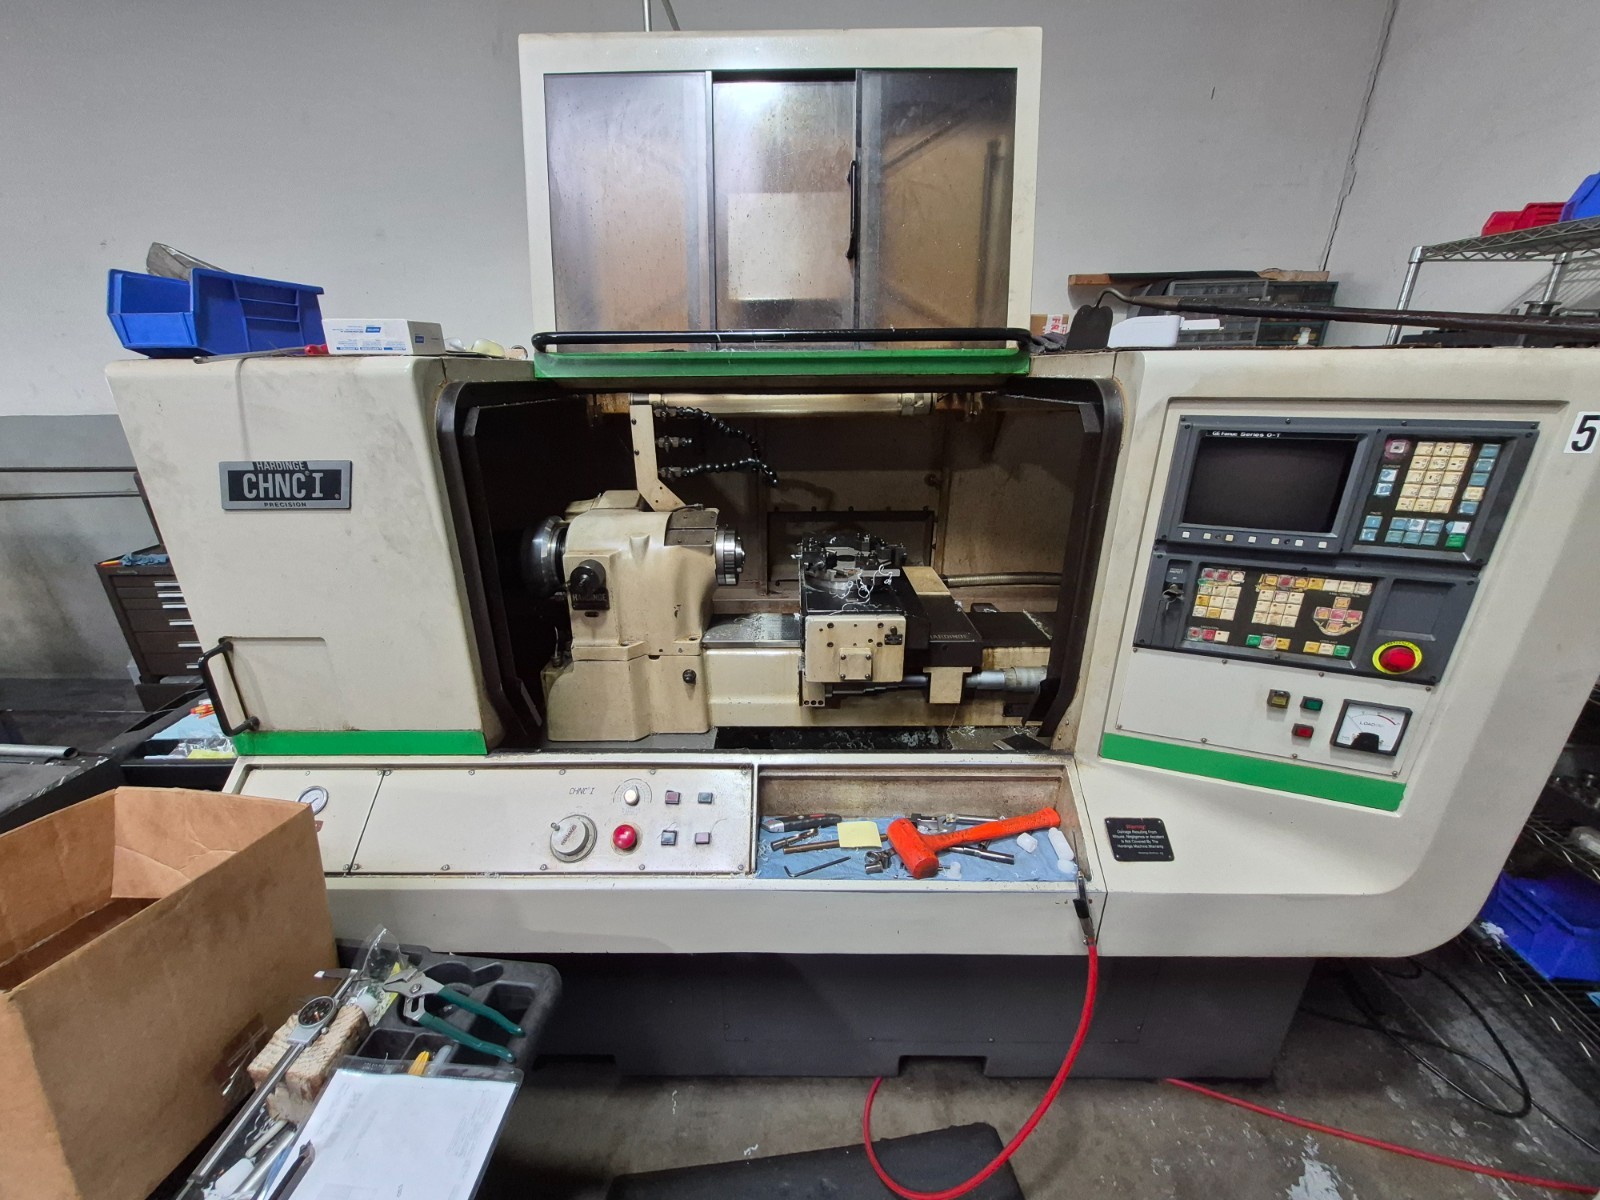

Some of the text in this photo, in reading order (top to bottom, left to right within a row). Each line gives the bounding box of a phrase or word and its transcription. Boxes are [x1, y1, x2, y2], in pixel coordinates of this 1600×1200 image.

[1571, 414, 1600, 452] 5
[257, 461, 306, 471] HARDINGE
[242, 472, 324, 499] CHNC I
